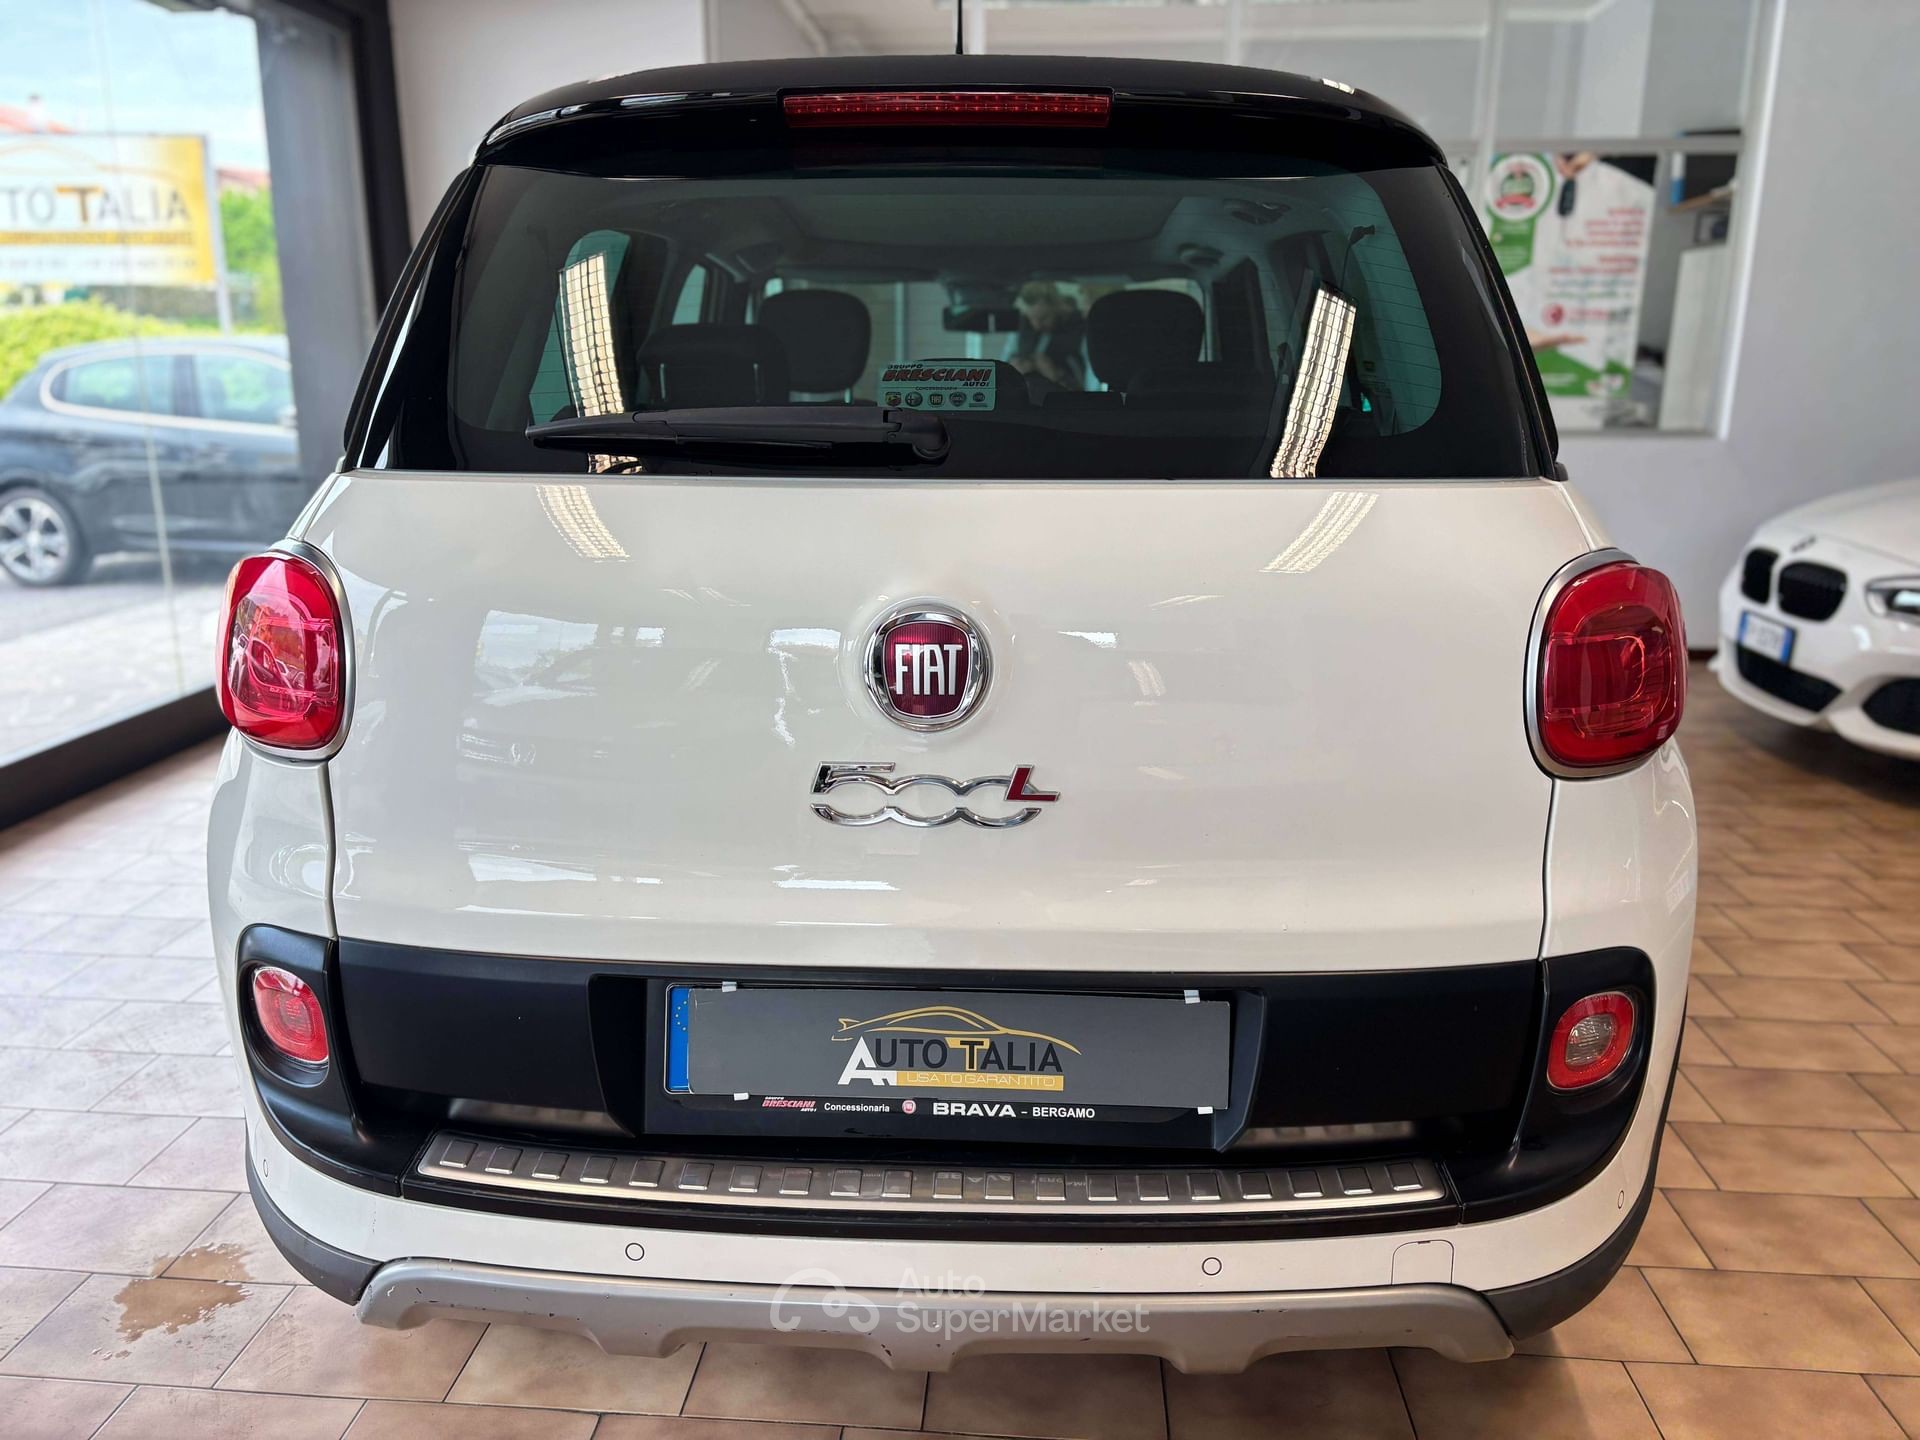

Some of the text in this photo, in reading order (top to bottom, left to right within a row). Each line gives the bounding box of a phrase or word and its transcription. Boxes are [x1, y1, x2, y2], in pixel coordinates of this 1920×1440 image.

[882, 368, 993, 381] BRESCIANI
[894, 643, 963, 696] FIAT
[810, 760, 1061, 829] 500L
[761, 1099, 816, 1109] BRESCIANI
[823, 1102, 890, 1113] Concessionaria
[932, 1102, 1017, 1118] BRAVA
[1032, 1106, 1096, 1119] BERGAMO
